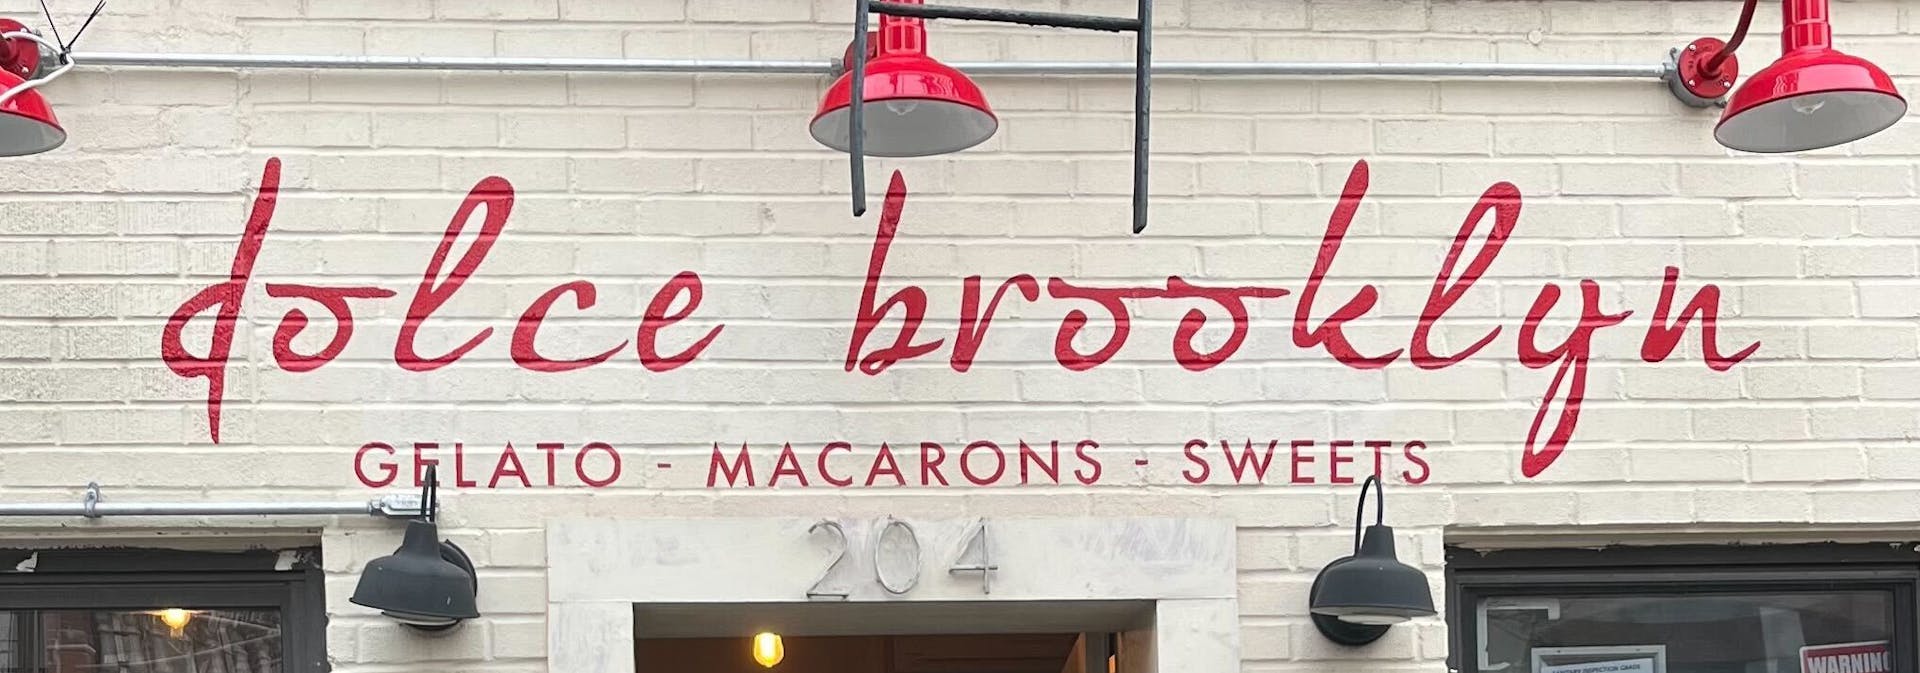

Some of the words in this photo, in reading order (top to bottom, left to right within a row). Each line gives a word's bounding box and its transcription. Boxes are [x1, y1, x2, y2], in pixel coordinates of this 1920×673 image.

[161, 157, 722, 444] dolce
[845, 160, 1760, 479] brooklyn
[354, 441, 622, 488] GELATO
[707, 439, 1101, 488] MACARONS
[1183, 439, 1431, 486] SWEETS
[806, 517, 998, 598] 204
